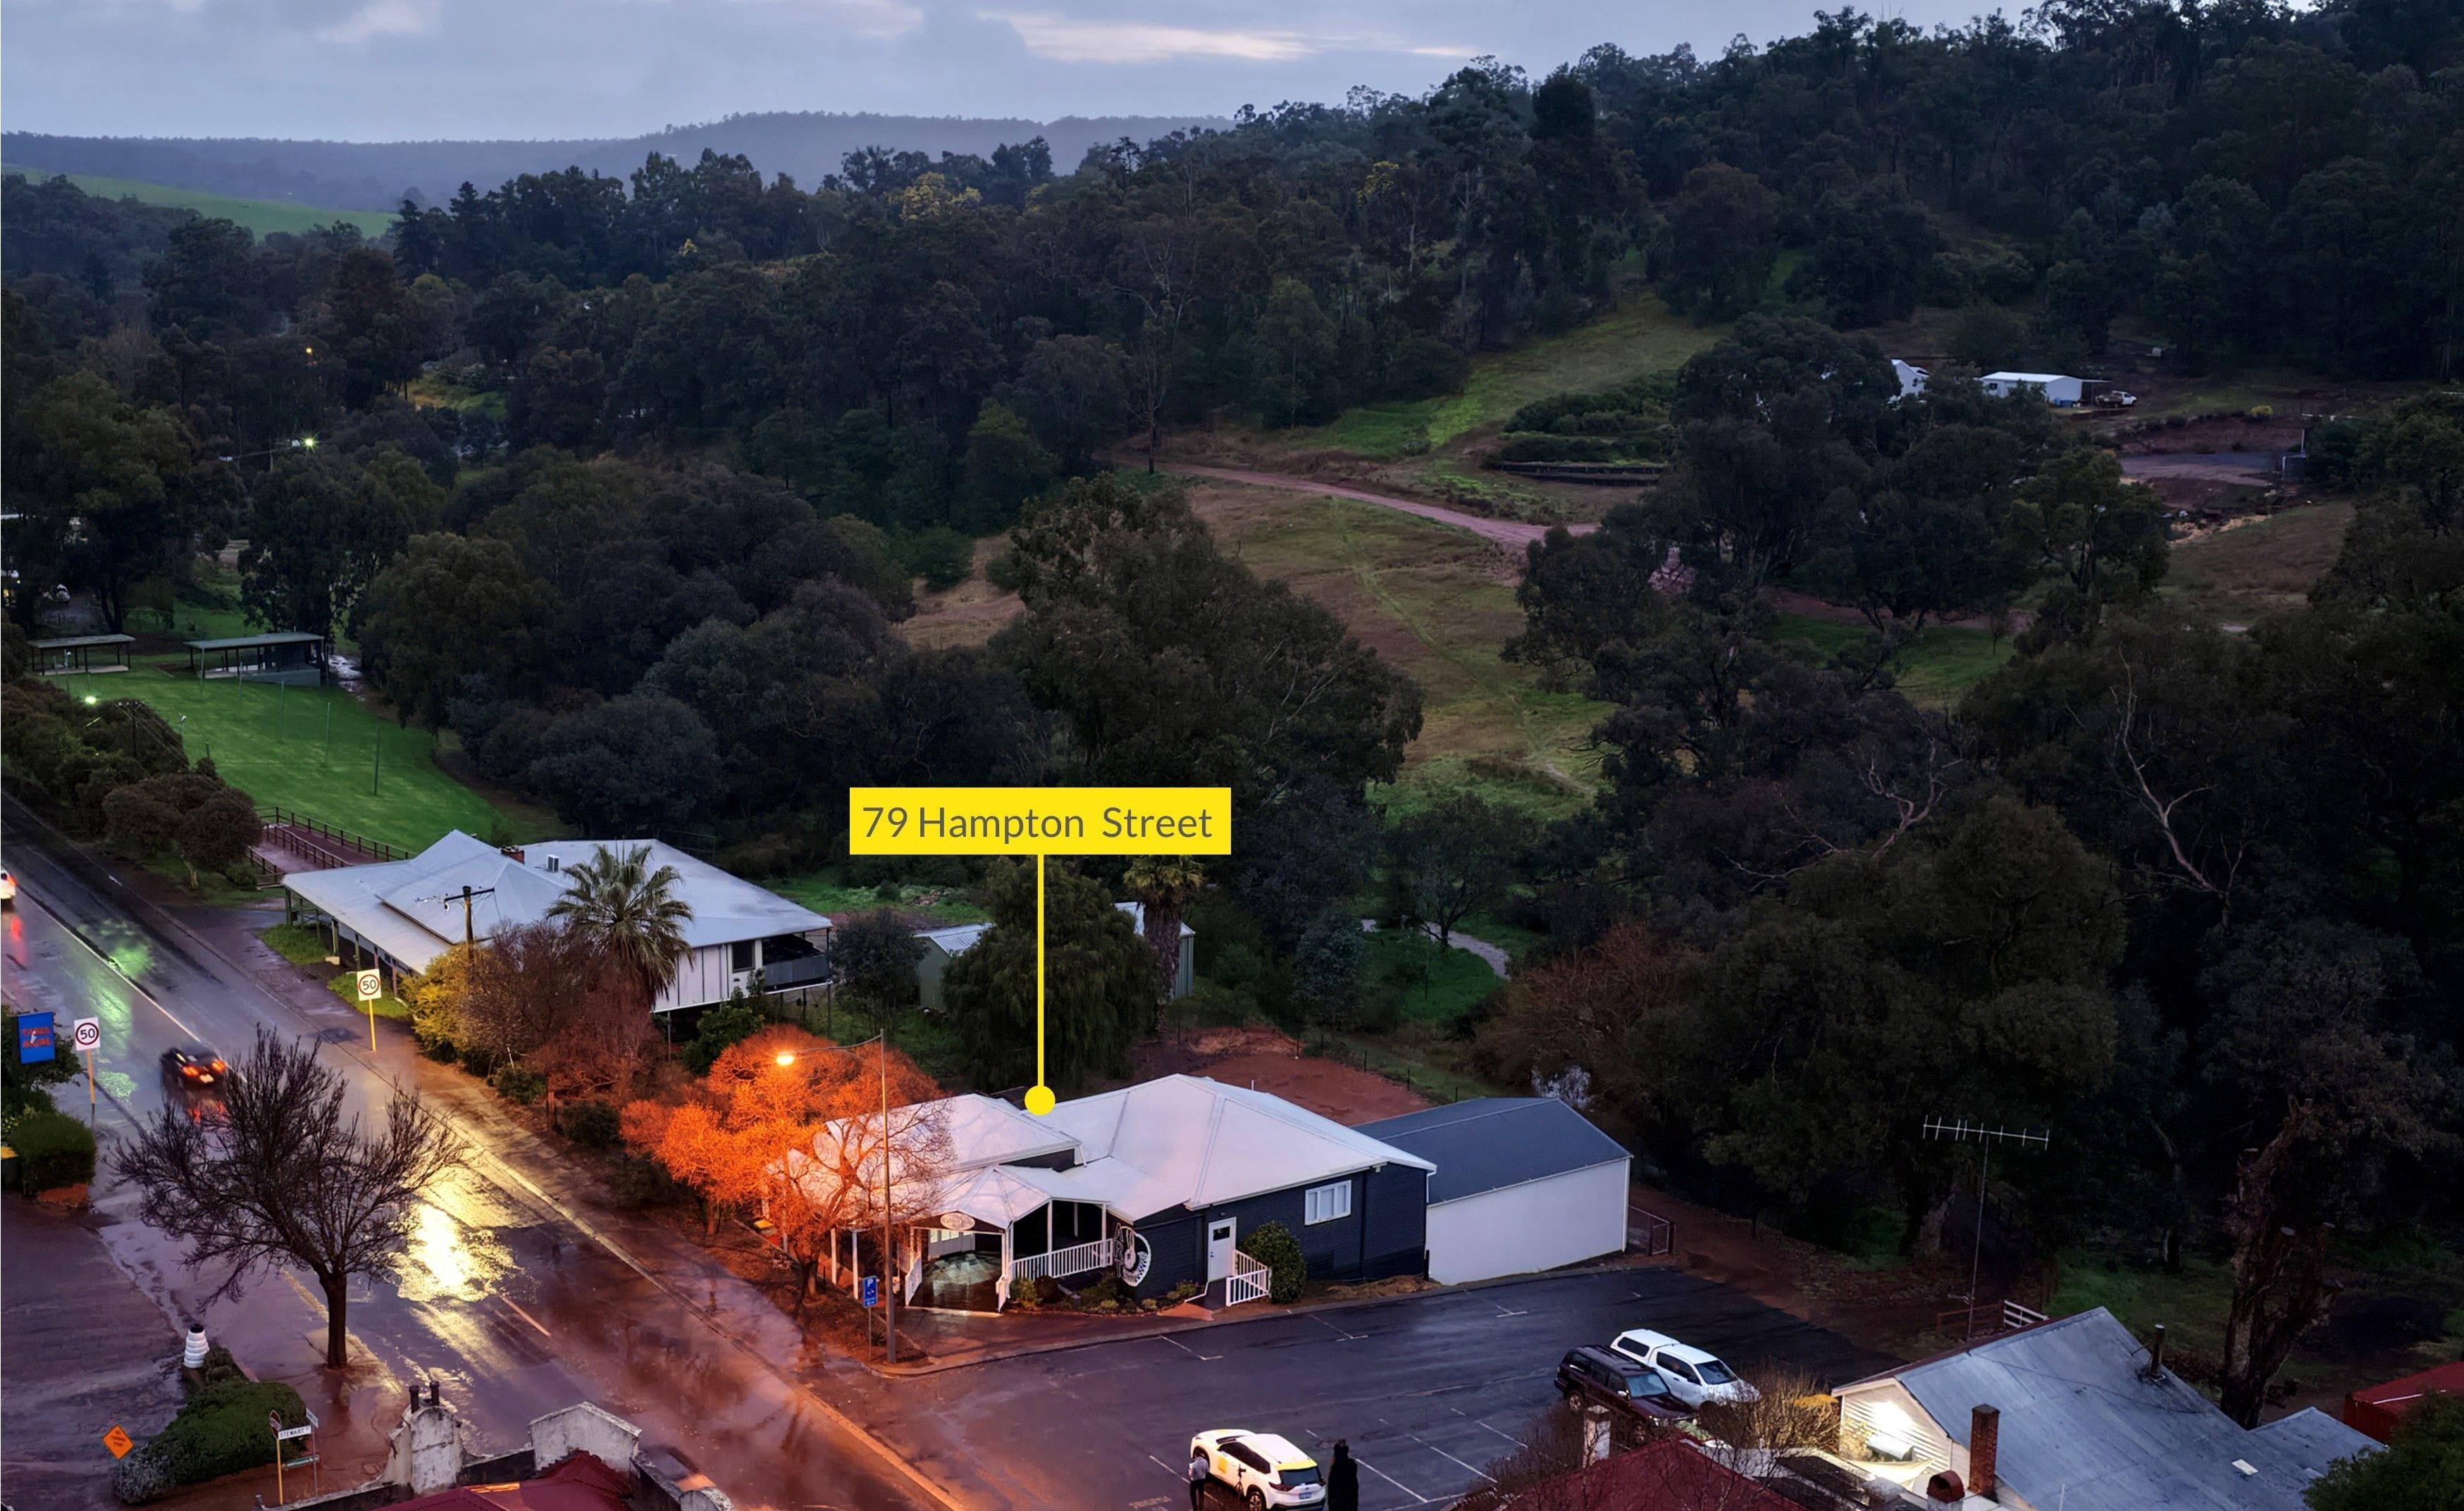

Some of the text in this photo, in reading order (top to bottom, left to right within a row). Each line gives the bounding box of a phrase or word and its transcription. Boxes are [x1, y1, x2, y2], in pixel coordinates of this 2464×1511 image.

[363, 980, 376, 990] 50
[80, 1028, 96, 1040] 50
[1114, 1222, 1125, 1279] ART
[867, 1279, 874, 1287] P
